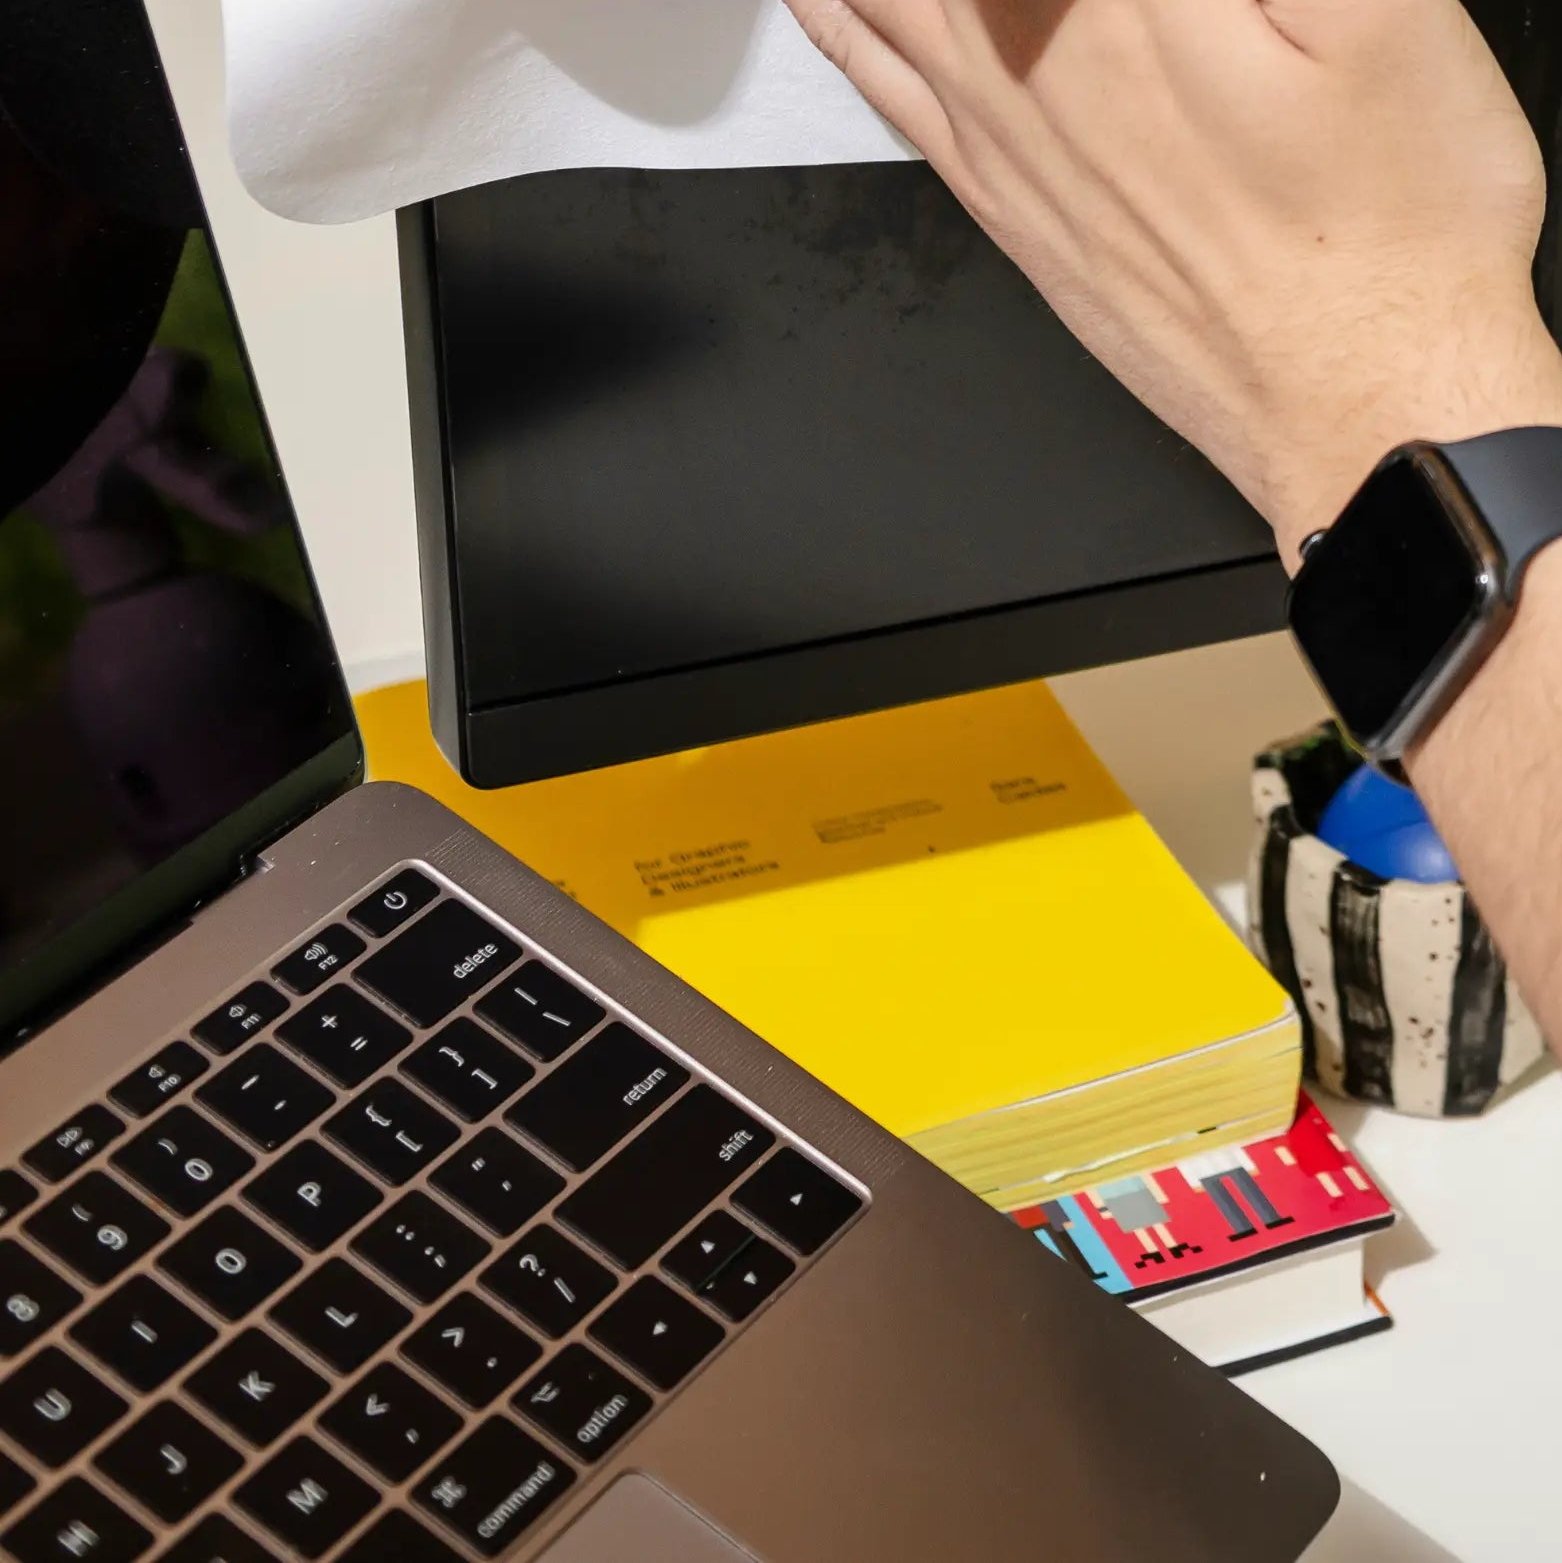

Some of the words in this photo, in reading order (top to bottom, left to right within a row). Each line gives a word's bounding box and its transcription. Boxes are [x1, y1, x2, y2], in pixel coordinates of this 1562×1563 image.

[319, 955, 338, 971] F12
[453, 944, 498, 978] delete
[241, 1014, 261, 1030] F11
[322, 1015, 337, 1028] +
[350, 1037, 368, 1051] =
[158, 1074, 182, 1093] F10
[471, 1068, 498, 1089] ]
[623, 1068, 667, 1106] return
[396, 1131, 423, 1152] [
[719, 1130, 755, 1163] shift
[297, 1182, 321, 1207] P
[97, 1225, 127, 1250] 9
[215, 1248, 246, 1274] O
[519, 1254, 545, 1277] ?
[7, 1294, 39, 1322] 8
[325, 1307, 357, 1328] L
[239, 1372, 274, 1401] K
[34, 1390, 71, 1420] U
[577, 1395, 627, 1443] option
[161, 1445, 186, 1474] J
[287, 1479, 326, 1514] M
[478, 1462, 555, 1539] command
[58, 1521, 98, 1556] H
